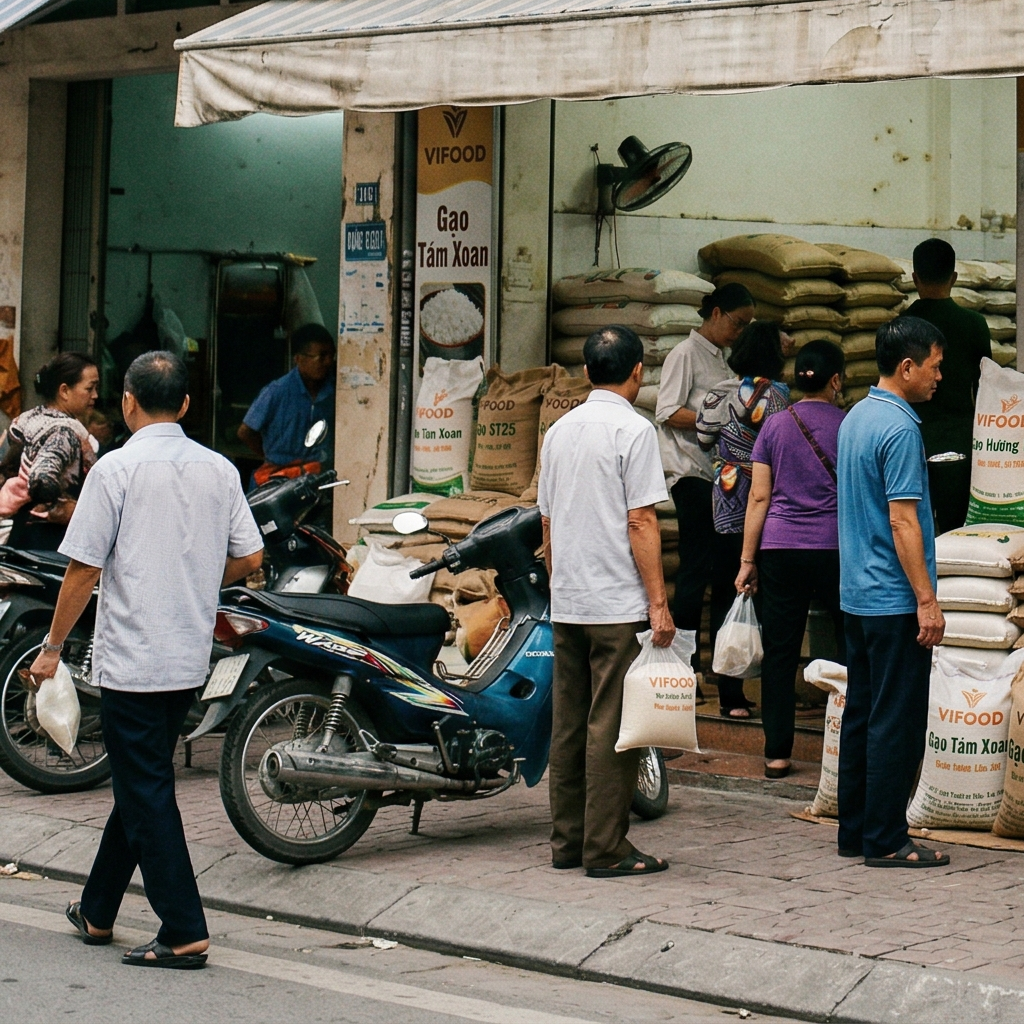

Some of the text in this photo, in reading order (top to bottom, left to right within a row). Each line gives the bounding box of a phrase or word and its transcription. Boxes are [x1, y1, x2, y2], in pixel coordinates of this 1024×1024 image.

[424, 145, 487, 165] VIFOOD
[437, 205, 469, 238] Gạo
[418, 241, 488, 267] Tám Xoan
[439, 428, 462, 439] Xoan
[489, 422, 516, 436] ST25
[939, 707, 1004, 726] VIFOOD
[928, 731, 947, 754] Gạo
[951, 737, 977, 754] Tám
